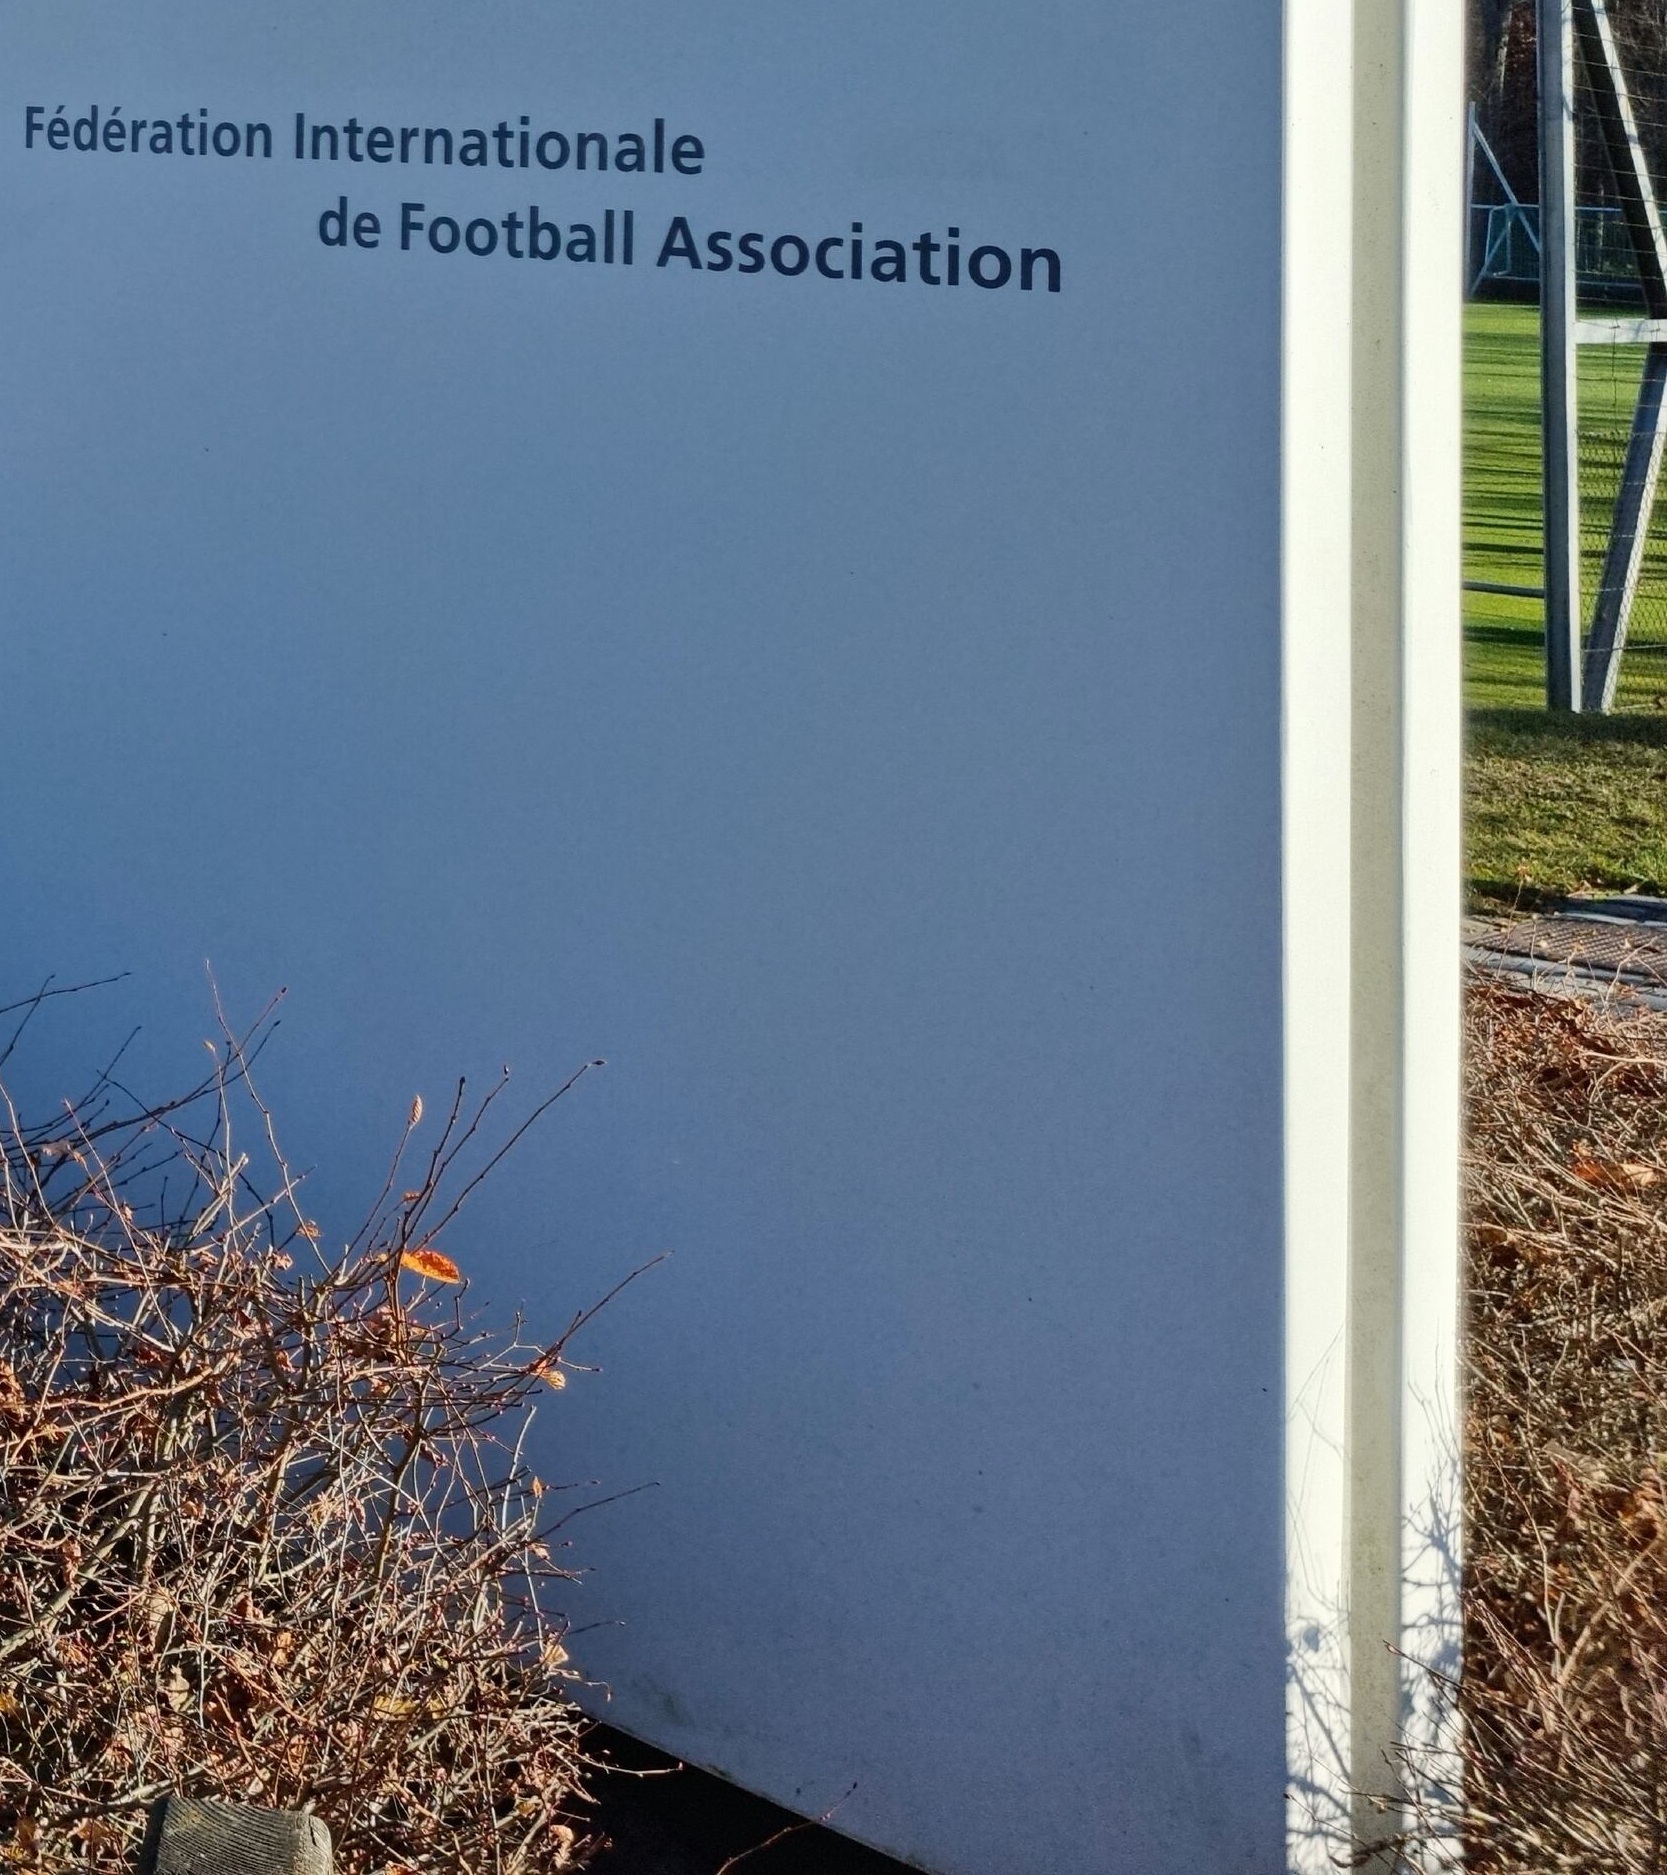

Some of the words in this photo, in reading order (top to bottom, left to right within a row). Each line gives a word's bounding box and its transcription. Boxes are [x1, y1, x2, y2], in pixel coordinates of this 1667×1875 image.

[24, 104, 274, 160] Fédération
[293, 112, 707, 177] Internationale
[317, 195, 383, 251] de
[399, 202, 636, 267] Football
[654, 215, 1063, 294] Association
